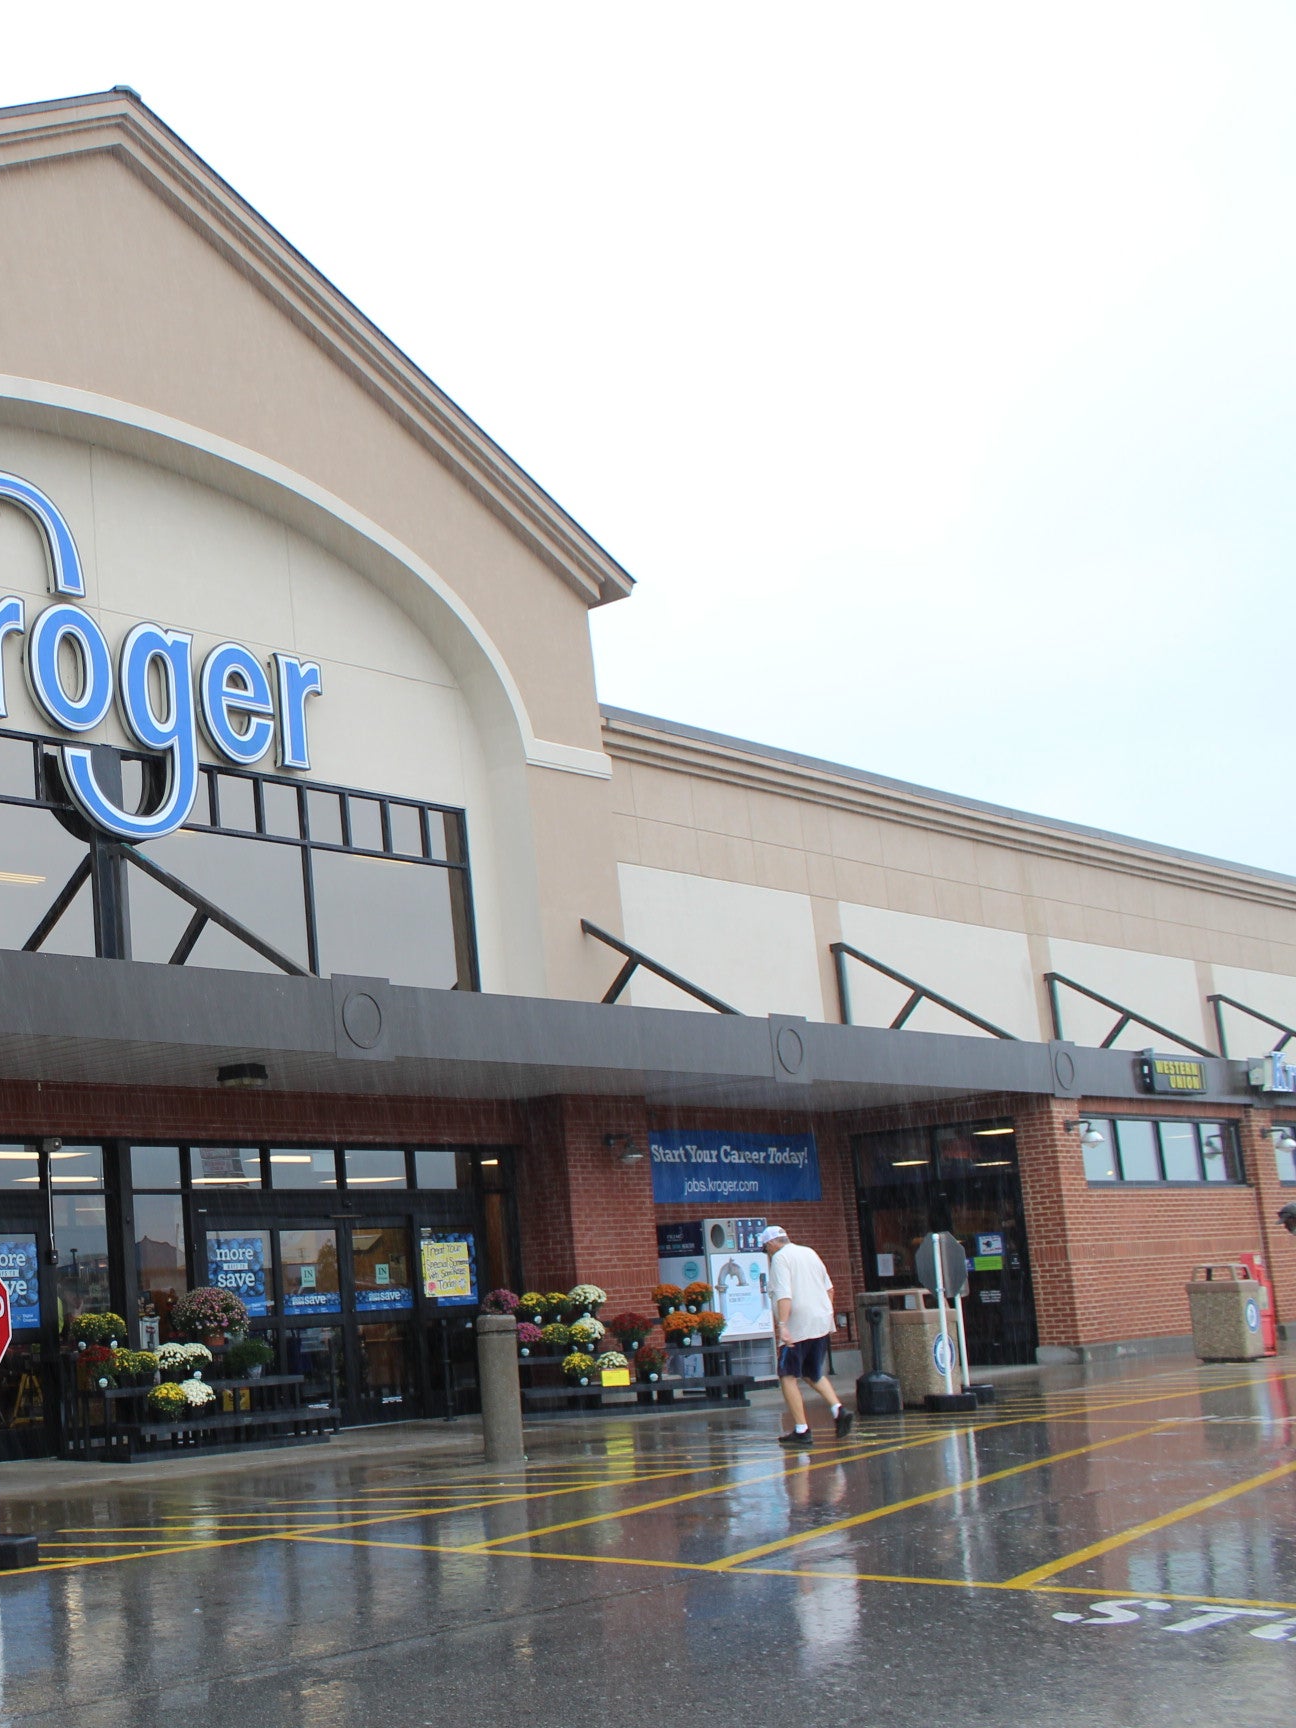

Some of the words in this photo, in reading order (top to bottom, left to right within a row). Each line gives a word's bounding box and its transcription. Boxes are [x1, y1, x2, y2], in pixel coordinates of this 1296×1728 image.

[1154, 1060, 1200, 1076] WESTERN
[1169, 1075, 1201, 1090] UNION
[650, 1144, 687, 1163] Start
[685, 1144, 718, 1163] Your
[720, 1145, 766, 1164] Career
[767, 1147, 808, 1168] Today!
[684, 1177, 759, 1196] jobs.kroger.com
[215, 1248, 254, 1260] more
[304, 1270, 313, 1279] IN
[378, 1267, 387, 1276] IN
[217, 1271, 256, 1288] save
[305, 1294, 327, 1306] save
[381, 1290, 402, 1301] save
